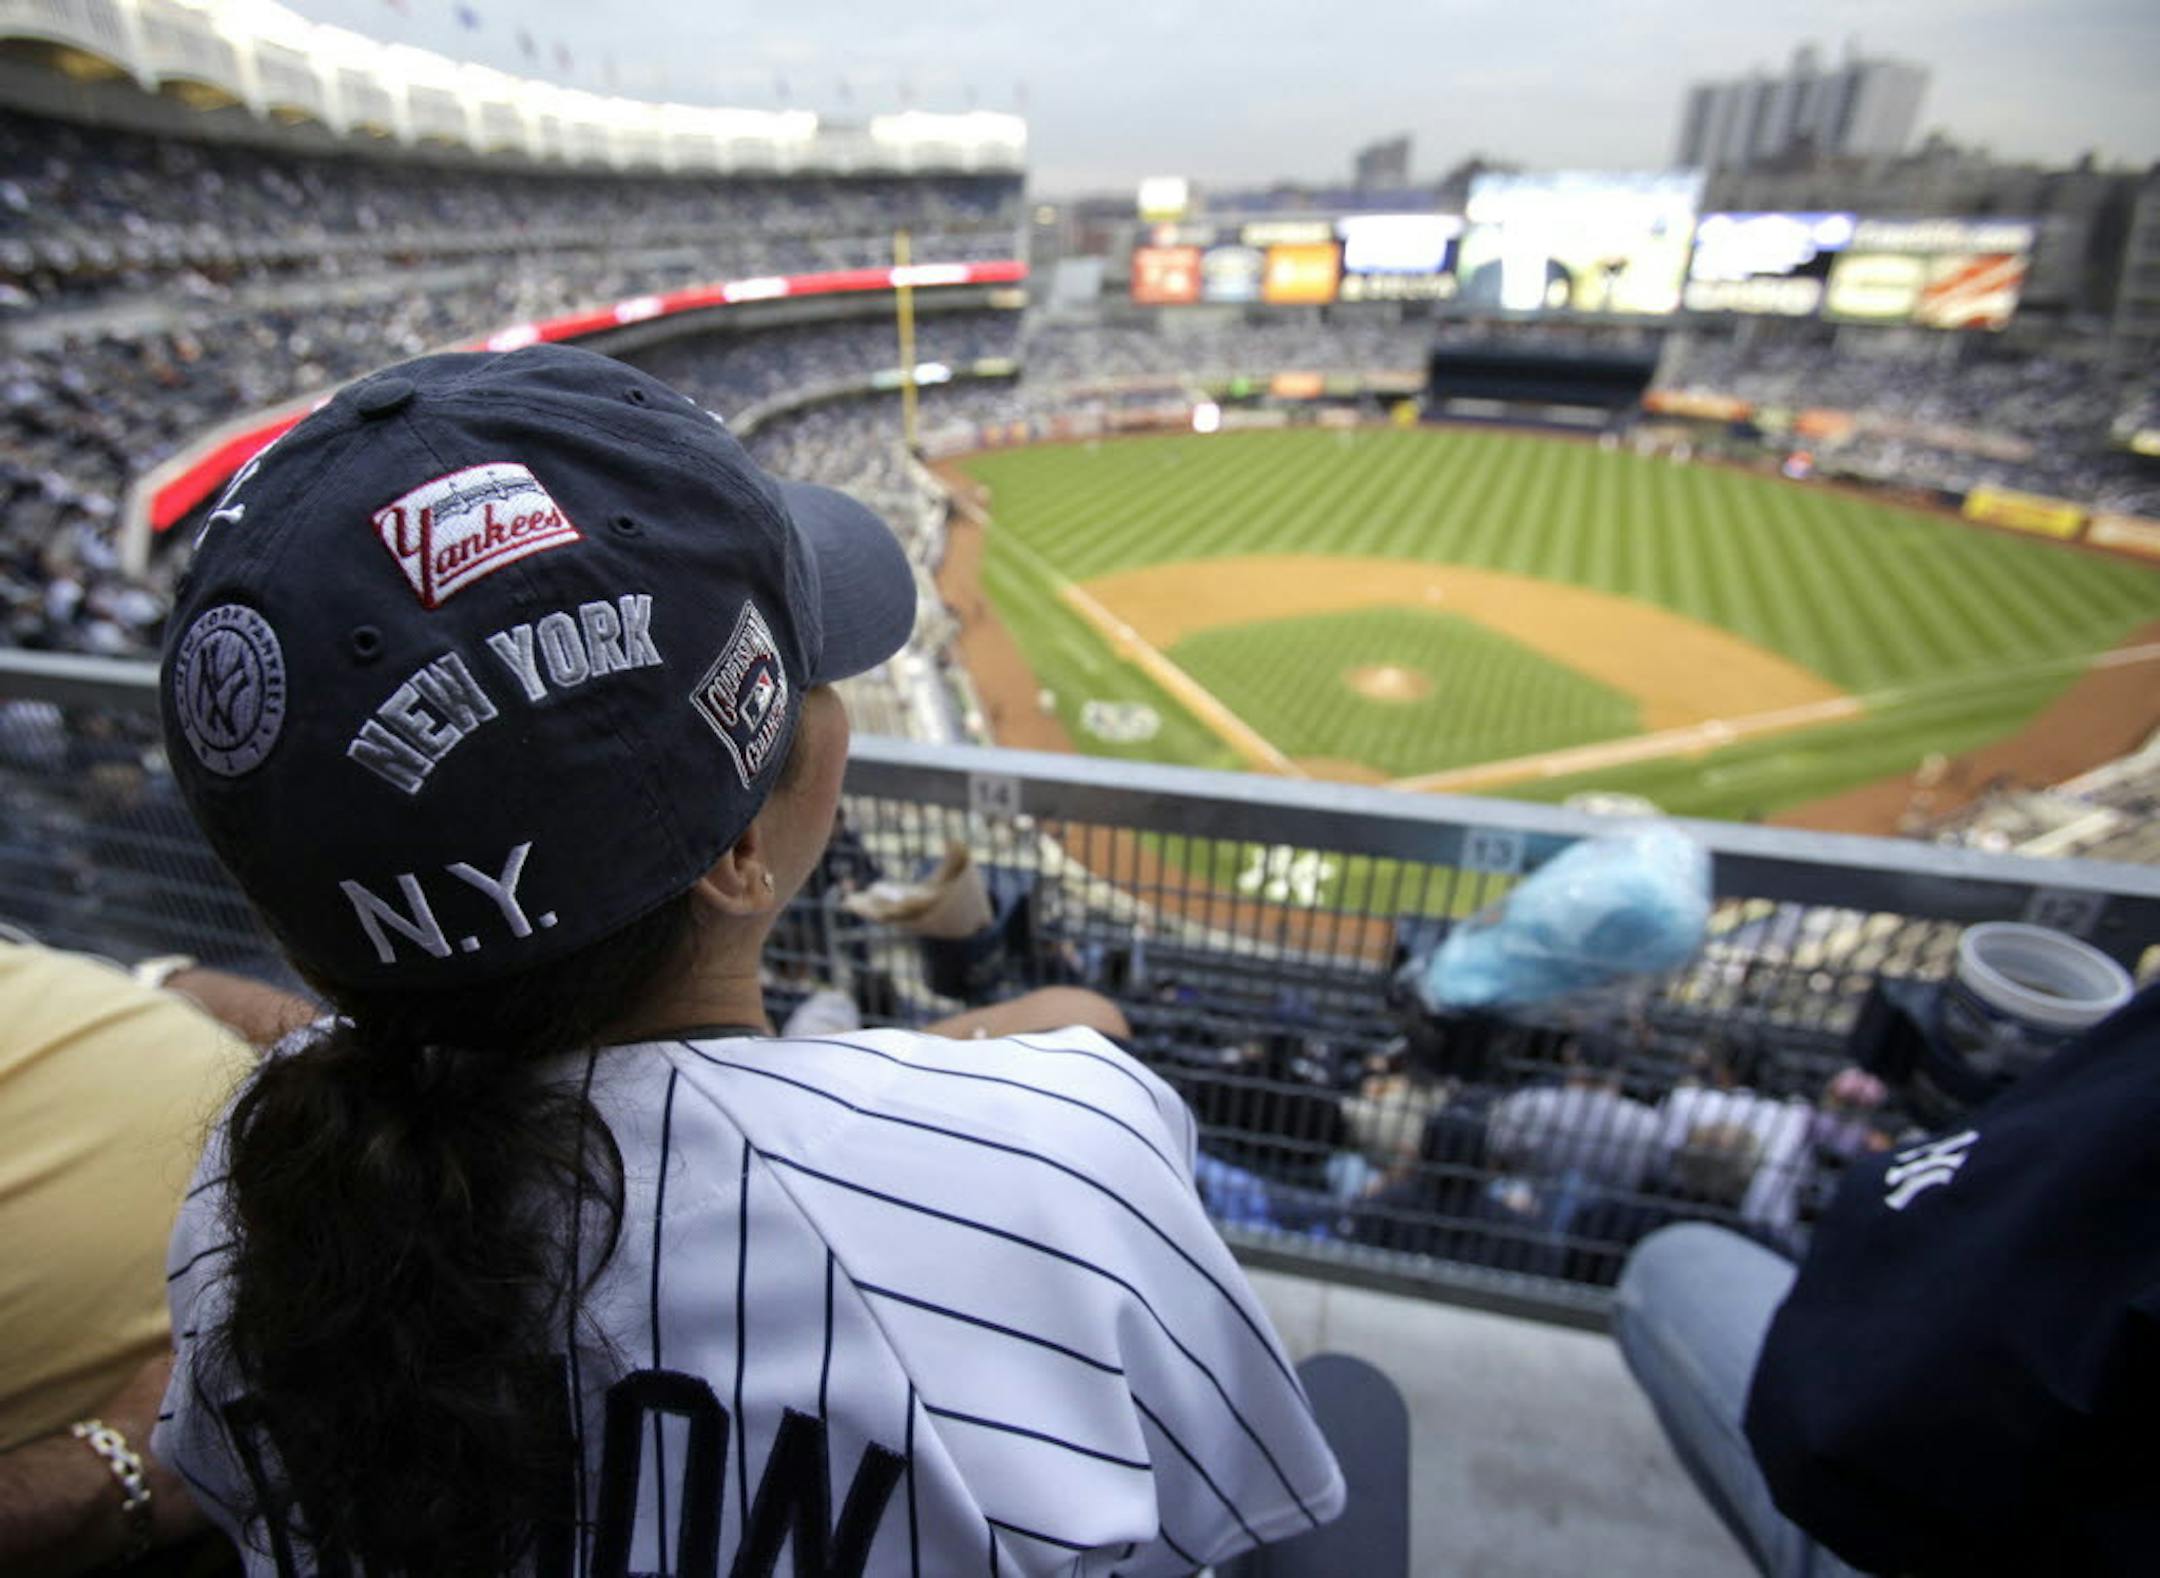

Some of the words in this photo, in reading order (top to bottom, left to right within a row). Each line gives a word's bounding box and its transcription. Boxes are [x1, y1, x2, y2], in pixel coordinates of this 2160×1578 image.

[370, 502, 562, 613] Yankees
[197, 607, 243, 631] YORK
[249, 615, 282, 715] YANKEES
[346, 651, 499, 794] NEW
[485, 594, 664, 702] YORK
[707, 625, 772, 728] COOPERST
[978, 780, 1012, 807] 14
[339, 841, 559, 964] N.Y.
[1474, 837, 1513, 868] 13
